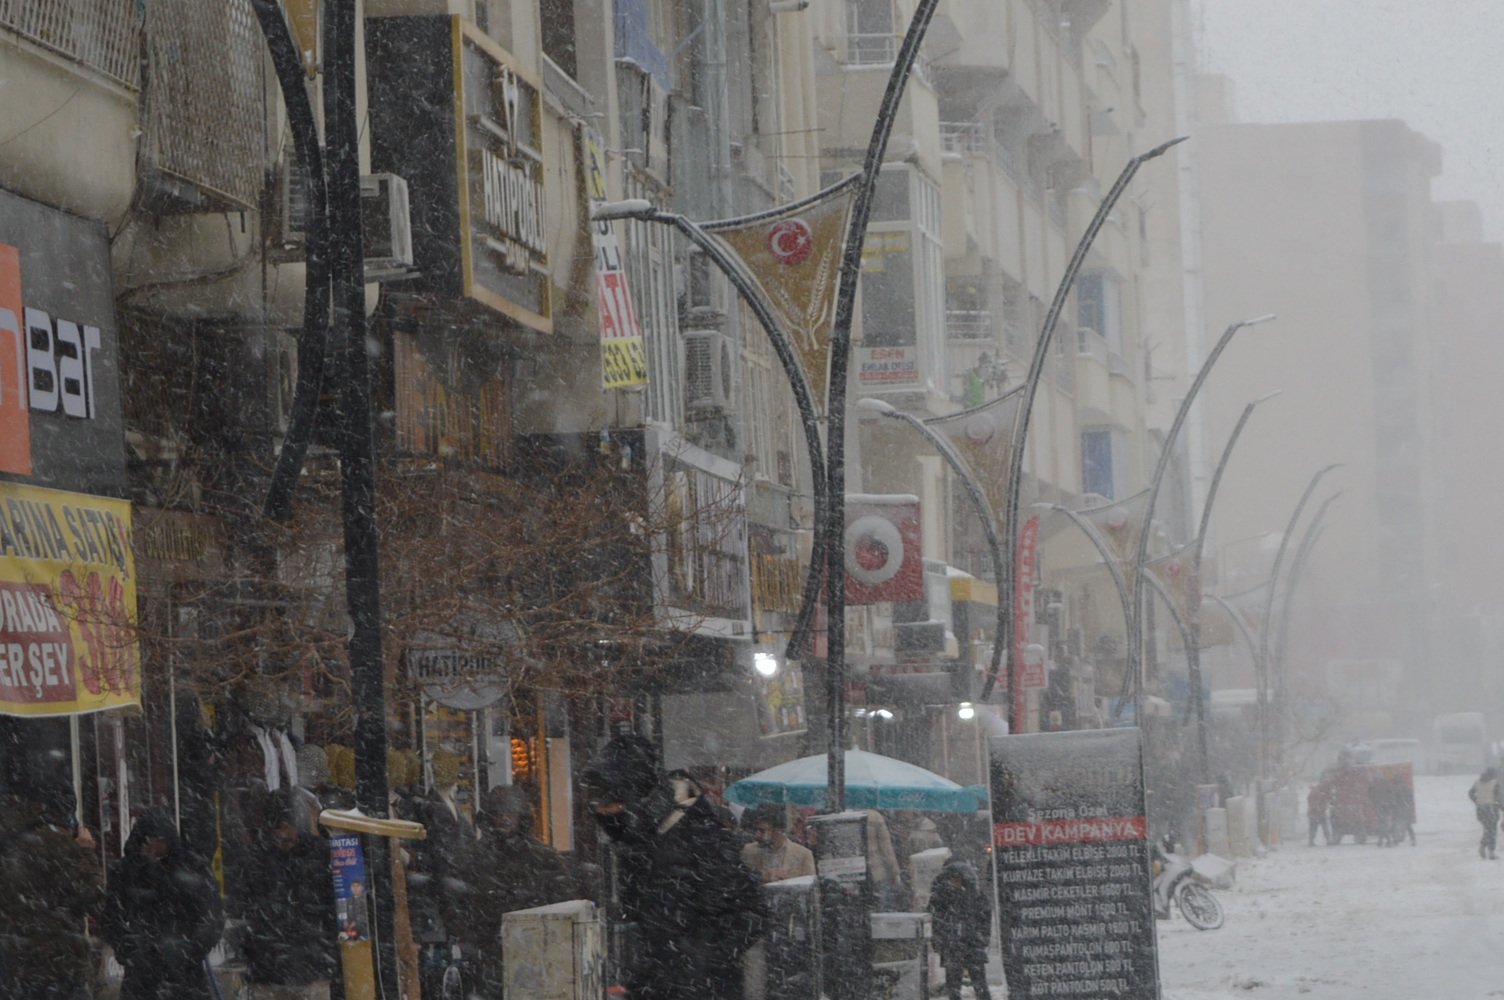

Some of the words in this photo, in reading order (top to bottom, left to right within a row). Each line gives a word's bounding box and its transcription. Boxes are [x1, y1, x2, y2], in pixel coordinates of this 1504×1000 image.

[0, 587, 62, 634] RADA
[28, 641, 71, 700] ŞEY
[1027, 807, 1076, 821] Sezona
[1078, 802, 1109, 817] Özel
[1003, 826, 1038, 843] DEV
[1040, 820, 1138, 841] KAMPANYA
[1129, 844, 1141, 857] TL
[1002, 867, 1045, 883] KURVAZE
[1045, 866, 1075, 881] TAKIM
[1132, 862, 1145, 876] TL
[1050, 884, 1099, 899] CEKETLER
[1122, 882, 1135, 895] TL
[1117, 902, 1130, 915] TL
[1010, 925, 1040, 939] YARIM
[1041, 924, 1070, 938] PALTO
[1130, 920, 1143, 933] TL
[1121, 940, 1134, 952] TL
[1023, 963, 1054, 976] KETEN
[1055, 961, 1104, 975] PANTOLON
[1122, 959, 1135, 972] TL
[1031, 982, 1050, 996] KOT
[1050, 980, 1099, 994] PANTOLON
[1118, 978, 1131, 991] TL
